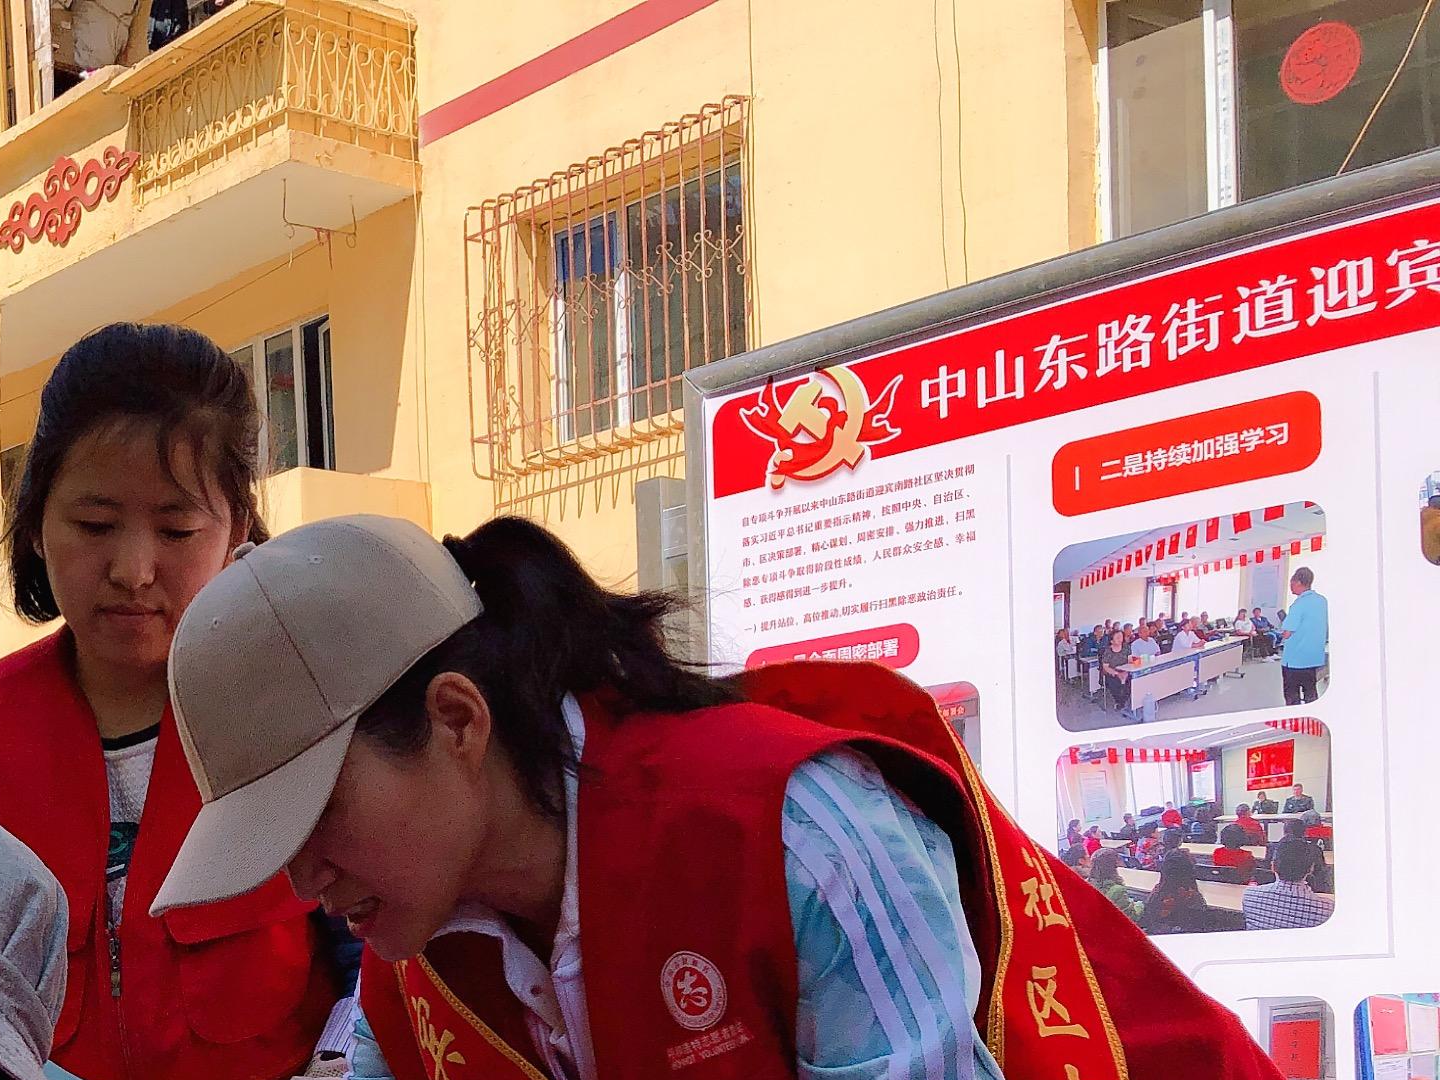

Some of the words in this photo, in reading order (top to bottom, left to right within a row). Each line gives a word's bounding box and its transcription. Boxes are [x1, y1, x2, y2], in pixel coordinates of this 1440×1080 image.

[920, 237, 1440, 420] 中山东路街道迎宾
[1100, 422, 1291, 484] 二是持续加强学习
